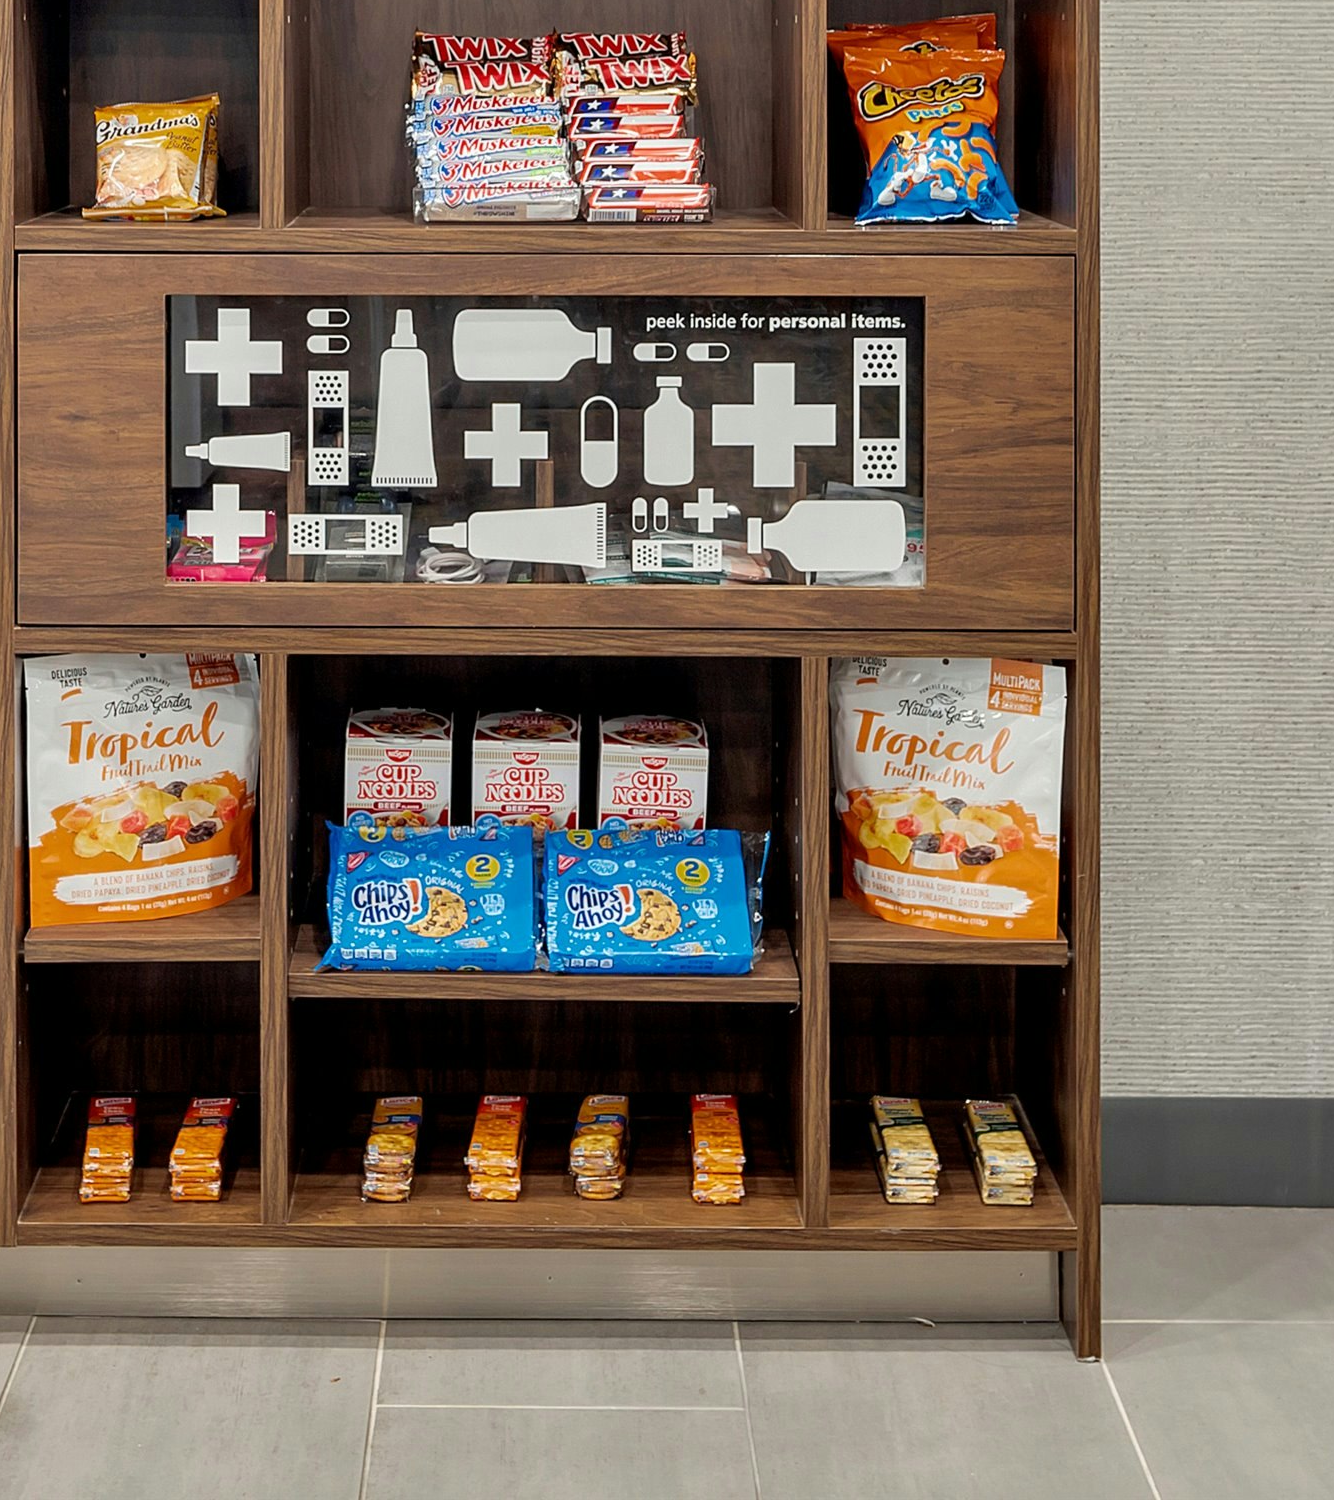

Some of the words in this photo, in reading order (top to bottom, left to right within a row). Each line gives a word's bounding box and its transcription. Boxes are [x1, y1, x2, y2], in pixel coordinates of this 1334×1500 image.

[423, 34, 527, 62] TWIX
[563, 33, 667, 58] TWIX
[446, 62, 551, 92] TWIX
[587, 56, 691, 90] TWIX
[863, 76, 980, 116] Cheetos
[96, 114, 200, 145] Grandma's
[167, 132, 199, 144] Peanut
[167, 140, 196, 153] Butter
[646, 313, 686, 332] peek
[689, 313, 736, 330] inside
[739, 313, 765, 330] for
[768, 313, 846, 332] personal
[851, 313, 906, 330] items.
[852, 657, 887, 668] DELICIOUS
[858, 665, 880, 677] TASTE
[51, 668, 87, 680] DELICIOUS
[59, 678, 83, 687] TASTE
[193, 672, 202, 686] 4
[104, 699, 149, 718] Nature's
[151, 693, 193, 715] Garden
[897, 700, 944, 719] Nature's
[990, 693, 1001, 707] 4
[61, 702, 225, 764] Tropical
[853, 709, 1015, 774] Tropical
[101, 760, 134, 781] Fruit
[134, 755, 168, 777] Trail
[168, 753, 202, 773] Mix
[376, 764, 421, 783] CUP
[503, 767, 549, 786] CUP
[883, 761, 917, 781] Fruit
[918, 763, 952, 783] Trail
[952, 769, 986, 790] Mix
[631, 771, 678, 790] CUP
[357, 780, 436, 801] NOODLES
[485, 783, 564, 803] NOODLES
[612, 786, 692, 807] NOODLES
[378, 802, 399, 810] BEEF
[506, 805, 528, 813] BEEF
[632, 808, 656, 816] BEEF
[475, 857, 490, 872] 2
[684, 861, 699, 878] 2
[425, 875, 465, 894] ORIGINAL
[636, 880, 676, 896] ORIGINAL
[353, 882, 408, 908] Chips
[568, 886, 620, 911] Chips
